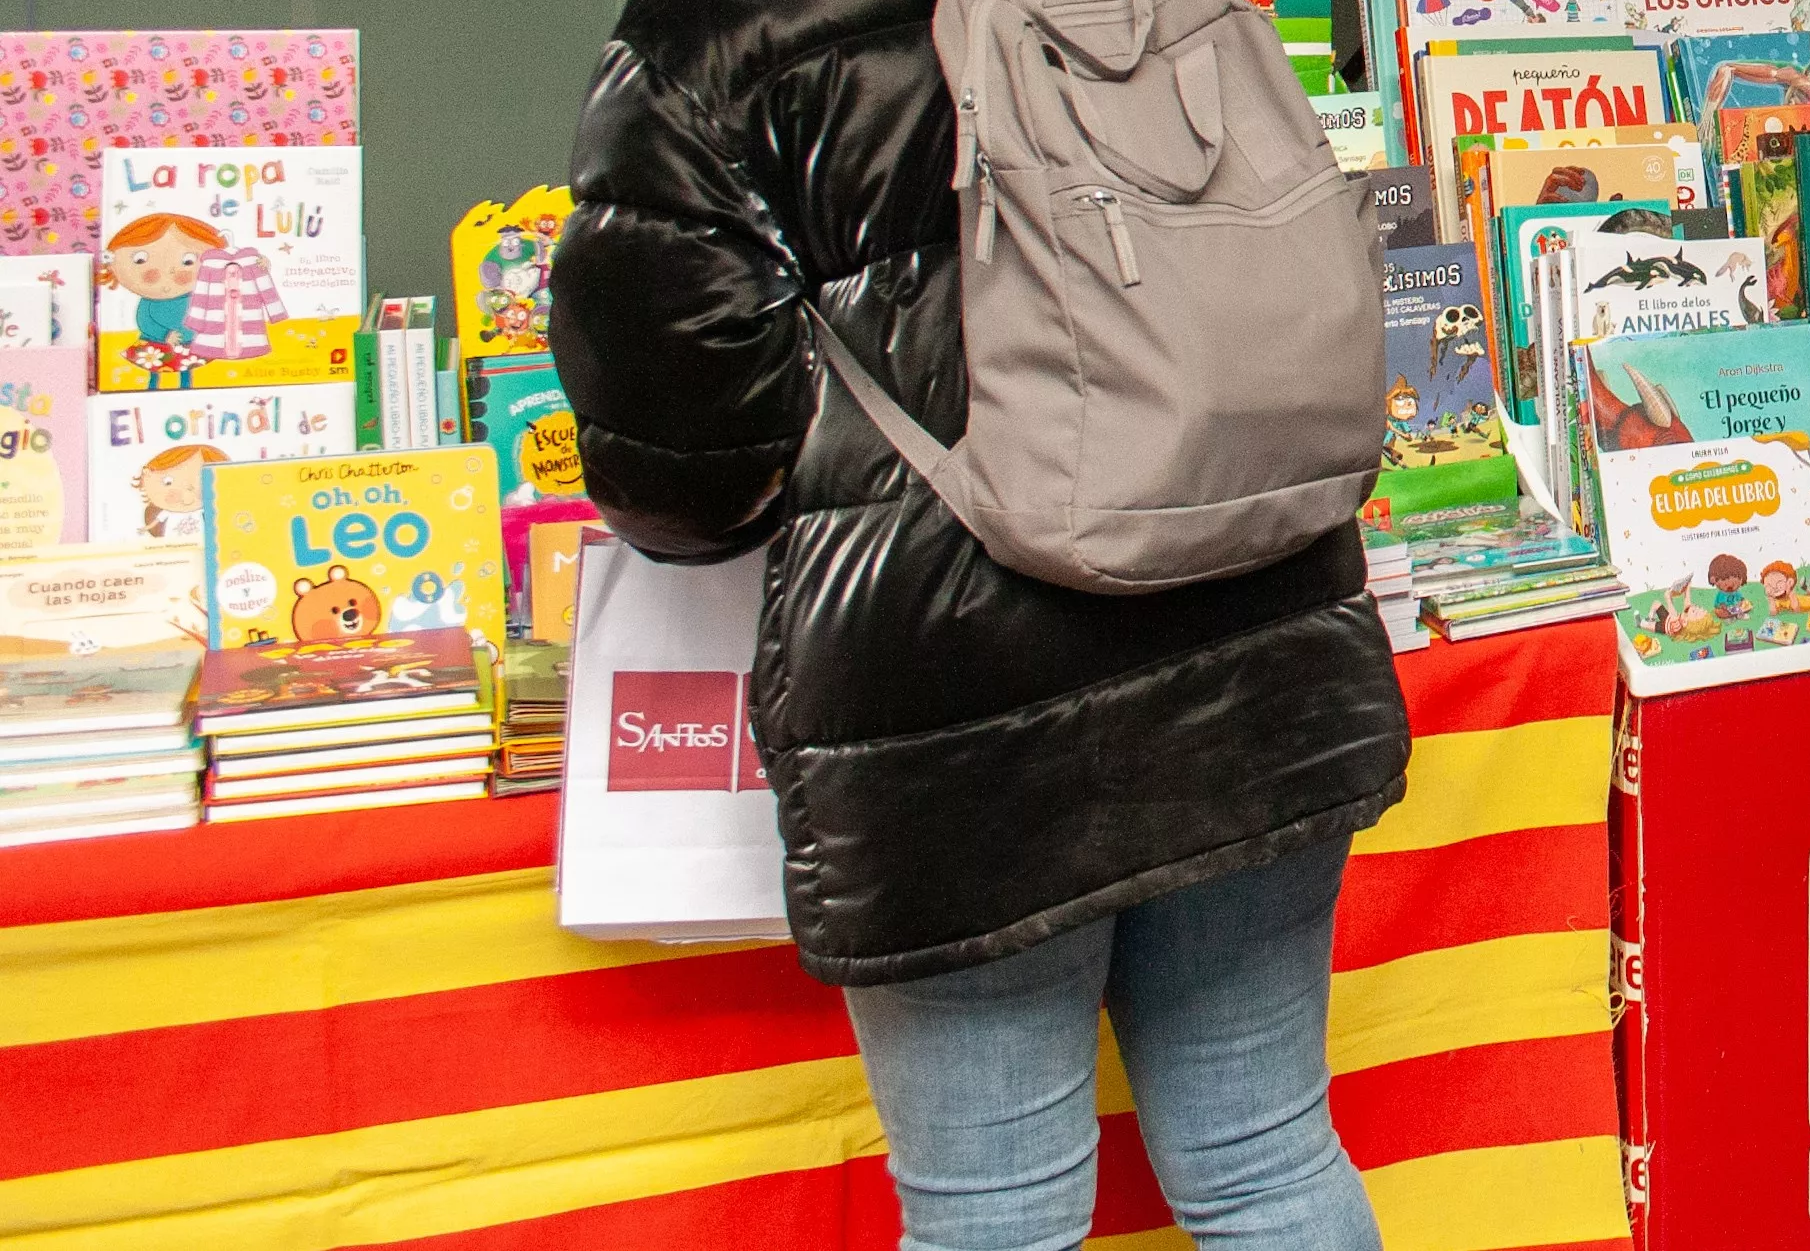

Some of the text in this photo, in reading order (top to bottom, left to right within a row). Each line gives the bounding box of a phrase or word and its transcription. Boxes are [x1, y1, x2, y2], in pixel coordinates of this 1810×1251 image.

[1512, 65, 1581, 86] pequeño
[122, 158, 287, 203] La ropa
[1645, 163, 1661, 175] 40
[210, 193, 241, 219] de
[256, 201, 324, 239] Lulú
[1638, 297, 1678, 311] El libro
[1621, 309, 1731, 335] ANIMALES
[1718, 362, 1785, 378] Aron Dijkstra
[1699, 384, 1802, 414] El pequeño
[109, 396, 329, 448] El orinal de
[1720, 415, 1787, 440] Jorge y
[298, 465, 335, 484] Chris
[311, 486, 360, 510] oh,
[1655, 479, 1778, 515] EL DÍA DEL LIBRO
[290, 510, 431, 569] Leo
[27, 574, 145, 595] Cuando caen
[45, 589, 128, 607] las hojas
